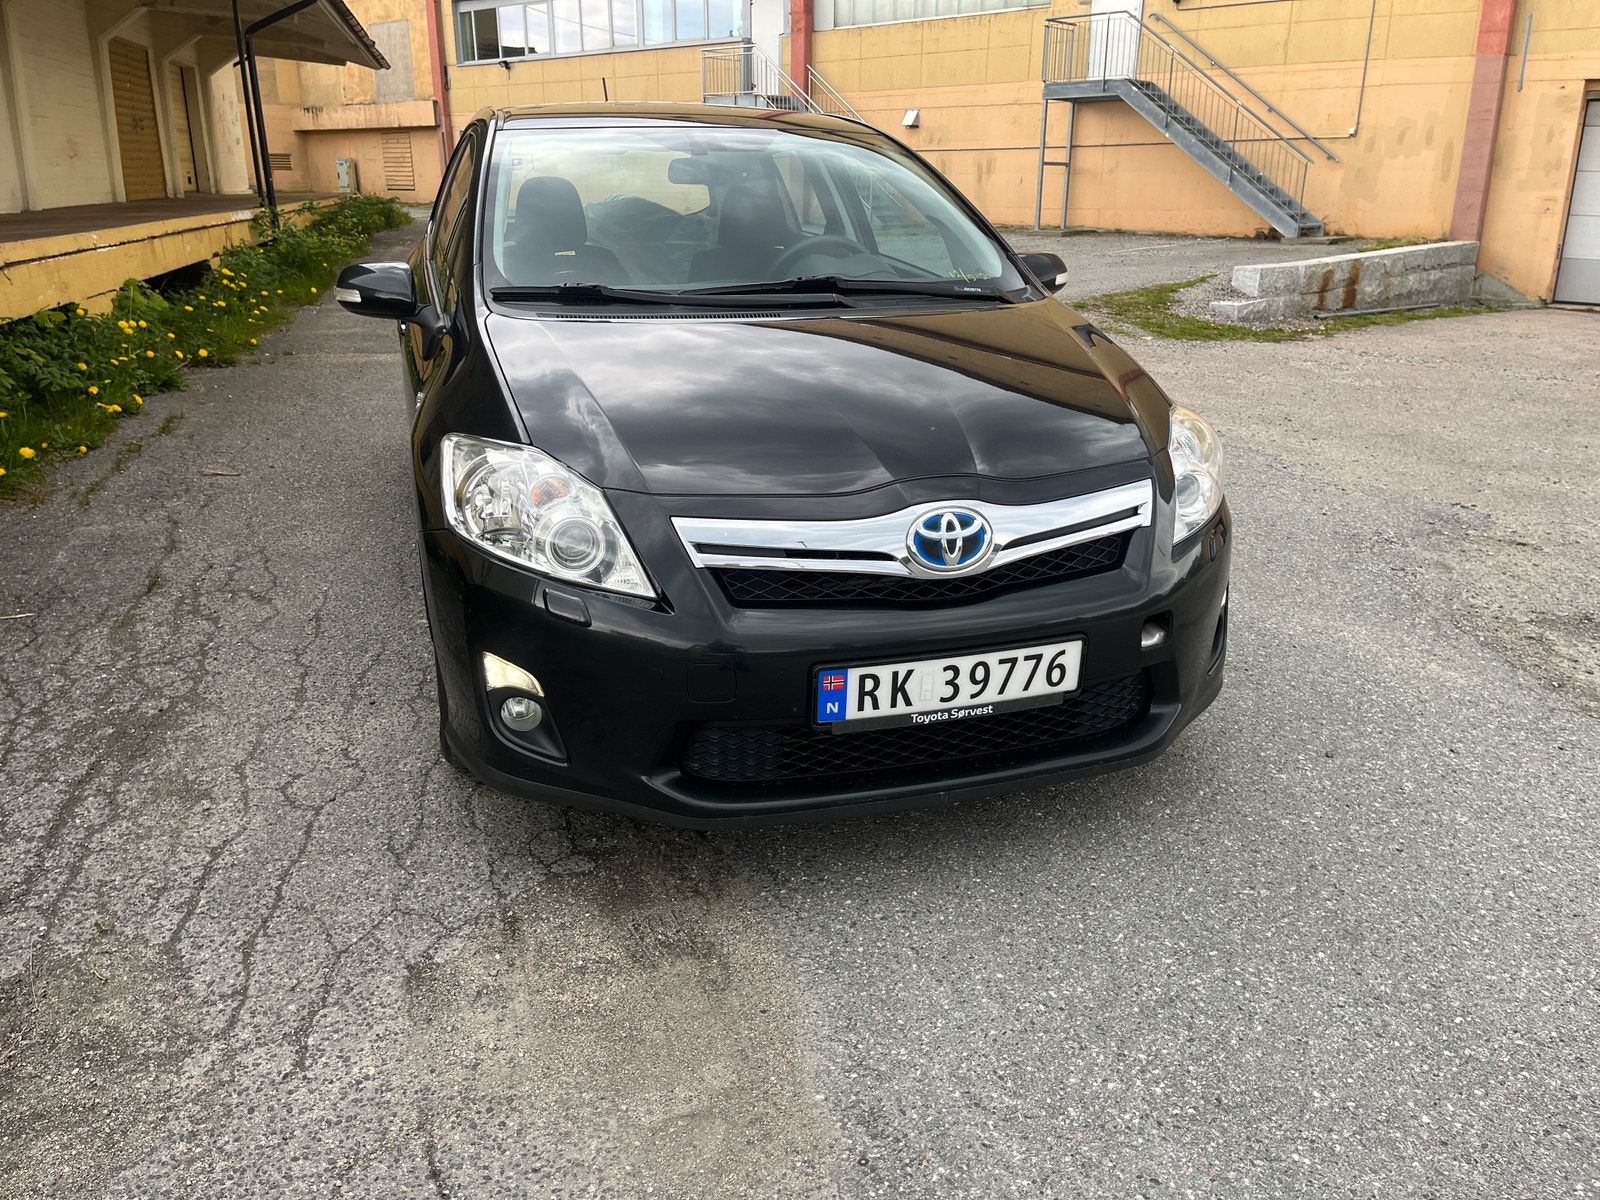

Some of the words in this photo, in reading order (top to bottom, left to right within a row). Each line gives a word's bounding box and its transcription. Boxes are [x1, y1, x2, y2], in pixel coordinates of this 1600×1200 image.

[857, 668, 915, 712] RK
[939, 649, 1067, 703] 39776
[826, 702, 839, 714] N
[911, 711, 949, 724] Toyota
[950, 704, 993, 719] Sørvest
